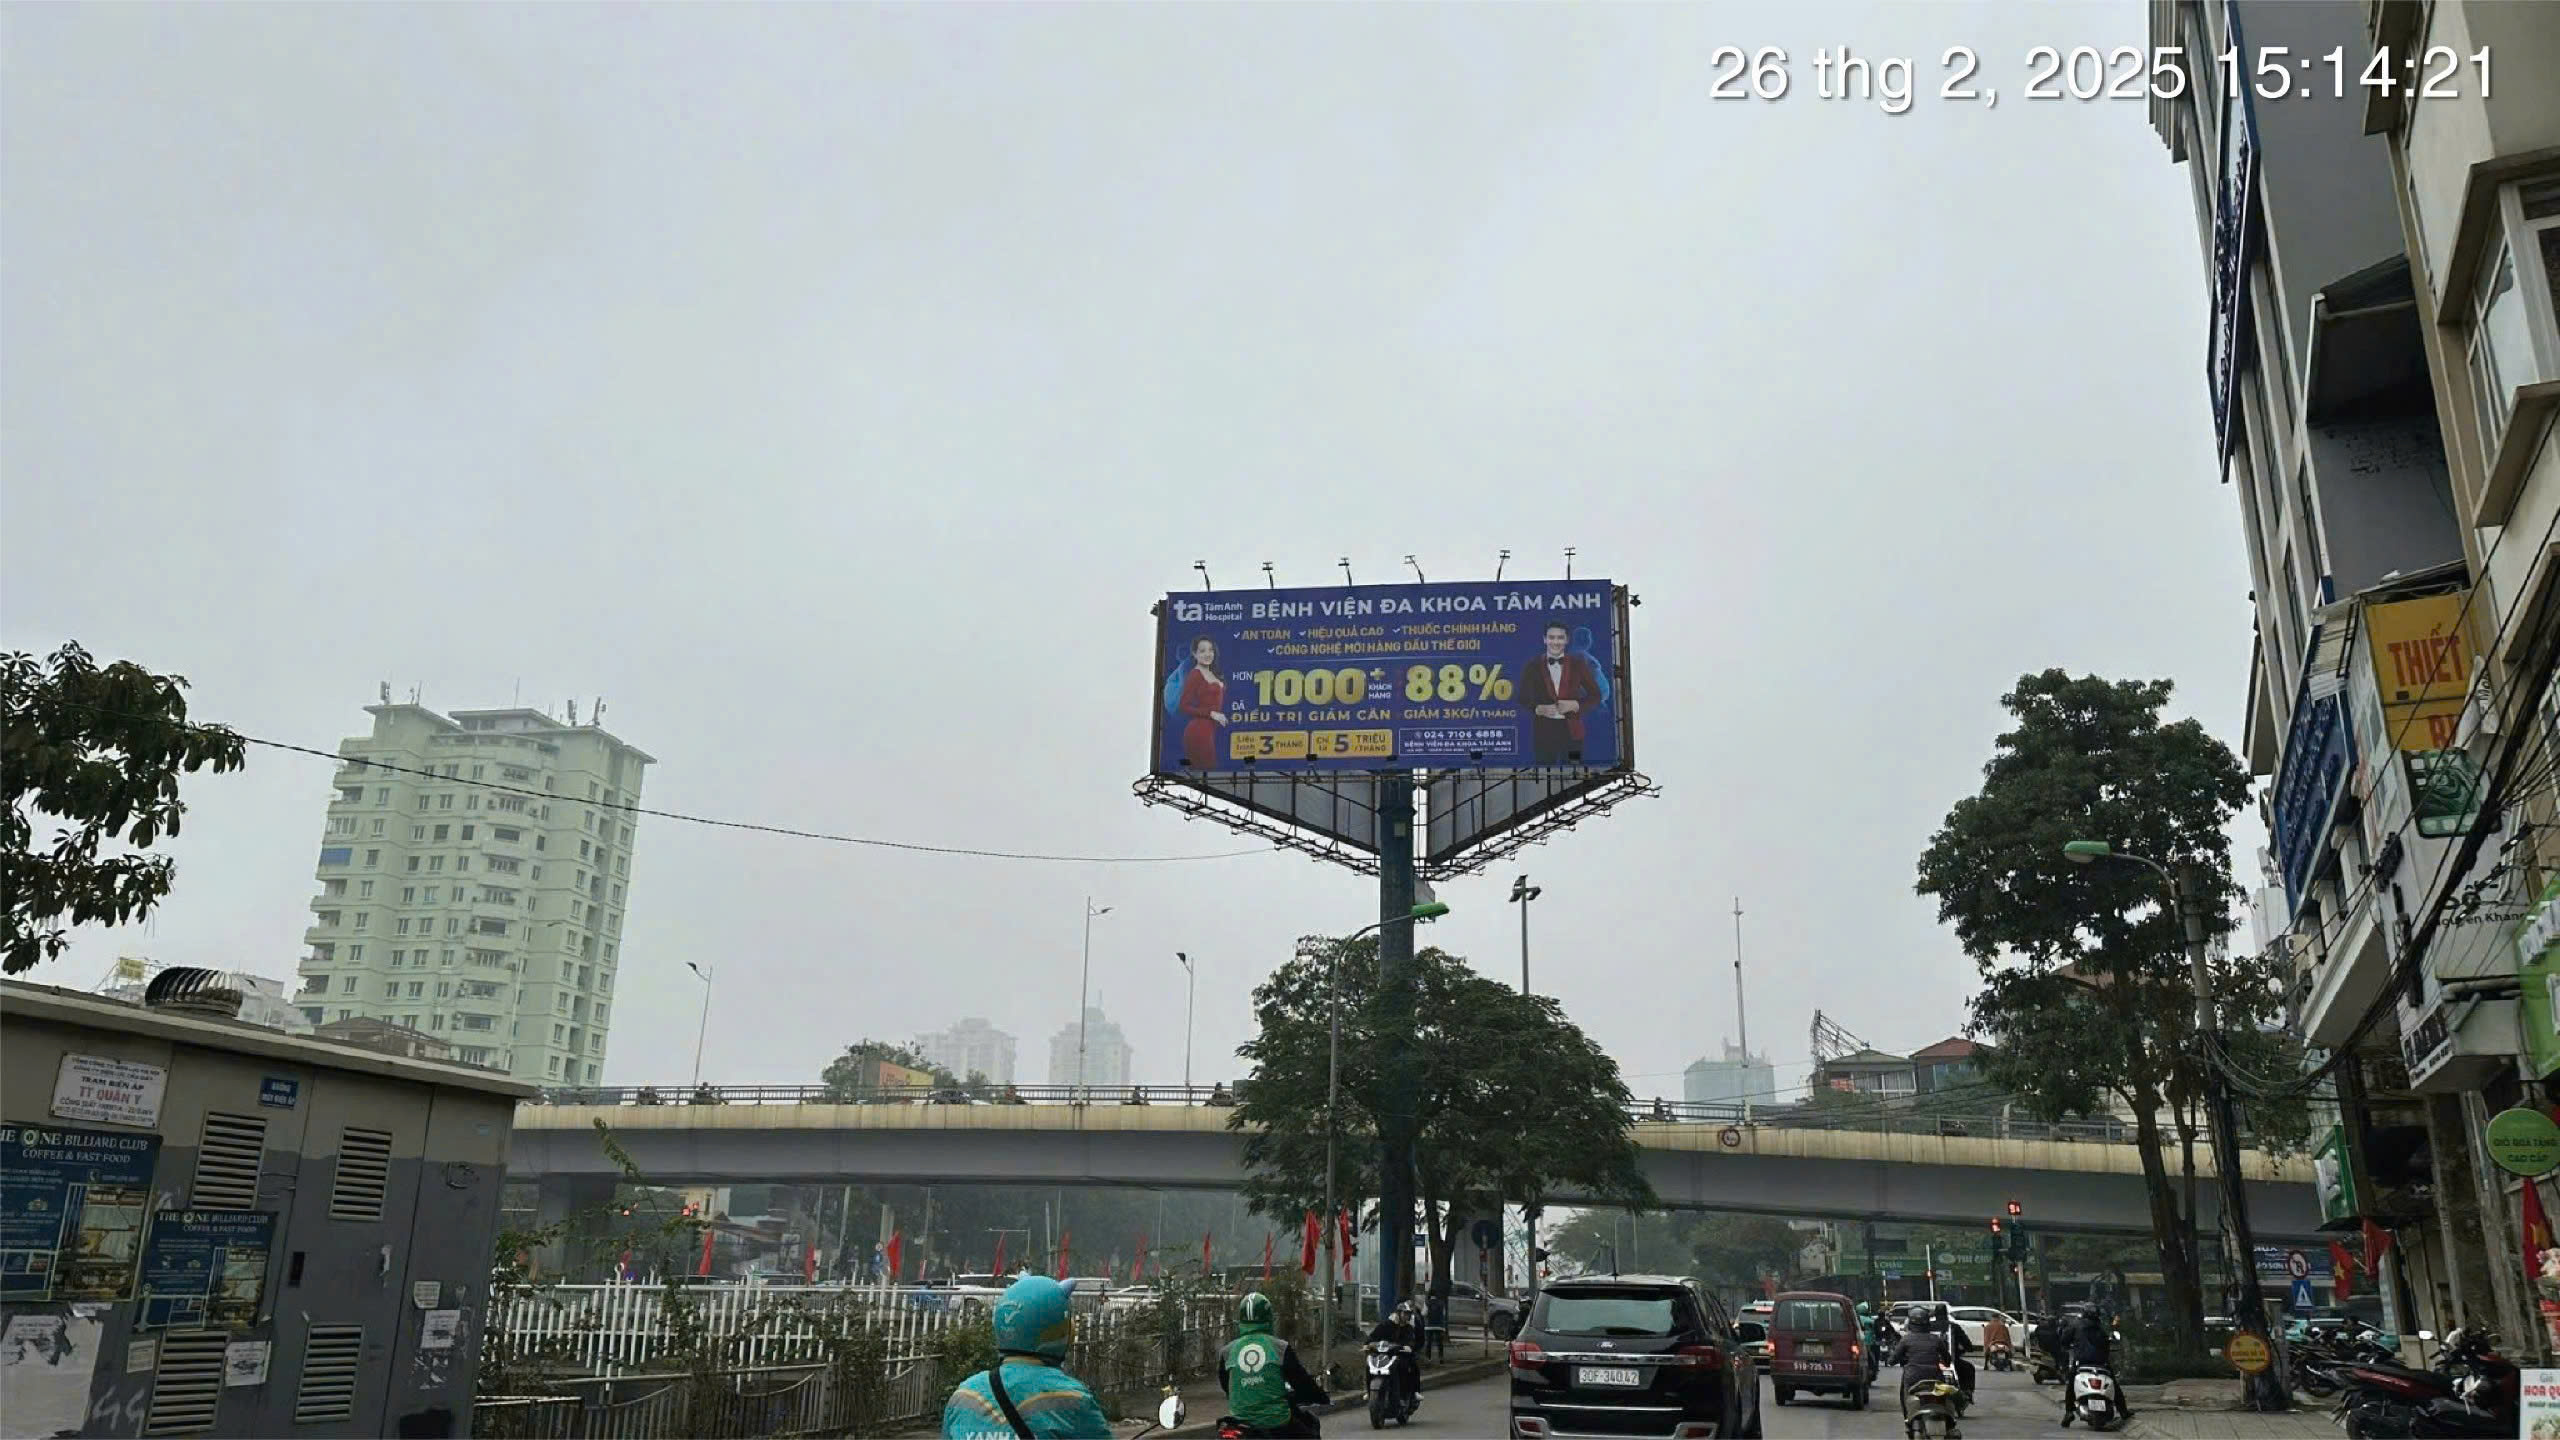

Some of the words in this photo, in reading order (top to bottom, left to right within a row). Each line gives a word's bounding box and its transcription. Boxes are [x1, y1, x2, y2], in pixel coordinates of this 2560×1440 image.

[1174, 600, 1202, 621] ta
[1224, 602, 1242, 611] Anh
[1252, 600, 1312, 620] BỆNH
[1320, 597, 1372, 620] VIỆN
[1380, 598, 1413, 614] ĐA
[1421, 596, 1486, 612] KHOA
[1494, 592, 1542, 611] TÂM
[1551, 593, 1600, 609] ANH
[1205, 613, 1242, 623] Hospital
[1241, 630, 1259, 640] AN
[1308, 627, 1333, 639] HIỆU
[1360, 627, 1384, 636] CAO
[1275, 644, 1307, 656] CÔNG
[1309, 643, 1342, 656] NGHỆ
[1432, 638, 1455, 650] THẾ
[2388, 622, 2464, 686] THIẾT
[1405, 664, 1513, 702] 88%
[1231, 709, 1270, 722] ĐIỀU
[1276, 711, 1301, 724] TRỊ
[1308, 708, 1350, 721] GIẢM
[1357, 707, 1391, 720] CÂN
[1403, 707, 1439, 719] GIẢM
[1356, 733, 1385, 744] TRIỆU
[1423, 730, 1444, 739] 024
[1448, 730, 1472, 739] 7106
[1258, 735, 1274, 755] 3
[1334, 735, 1350, 752] 5
[64, 1135, 118, 1149] BILLIARD
[119, 1138, 148, 1150] CLUB
[22, 1148, 64, 1160] COFFEE
[65, 1152, 74, 1160] &
[76, 1152, 101, 1162] FAST
[103, 1153, 131, 1163] FOOD
[160, 1212, 179, 1222] THE
